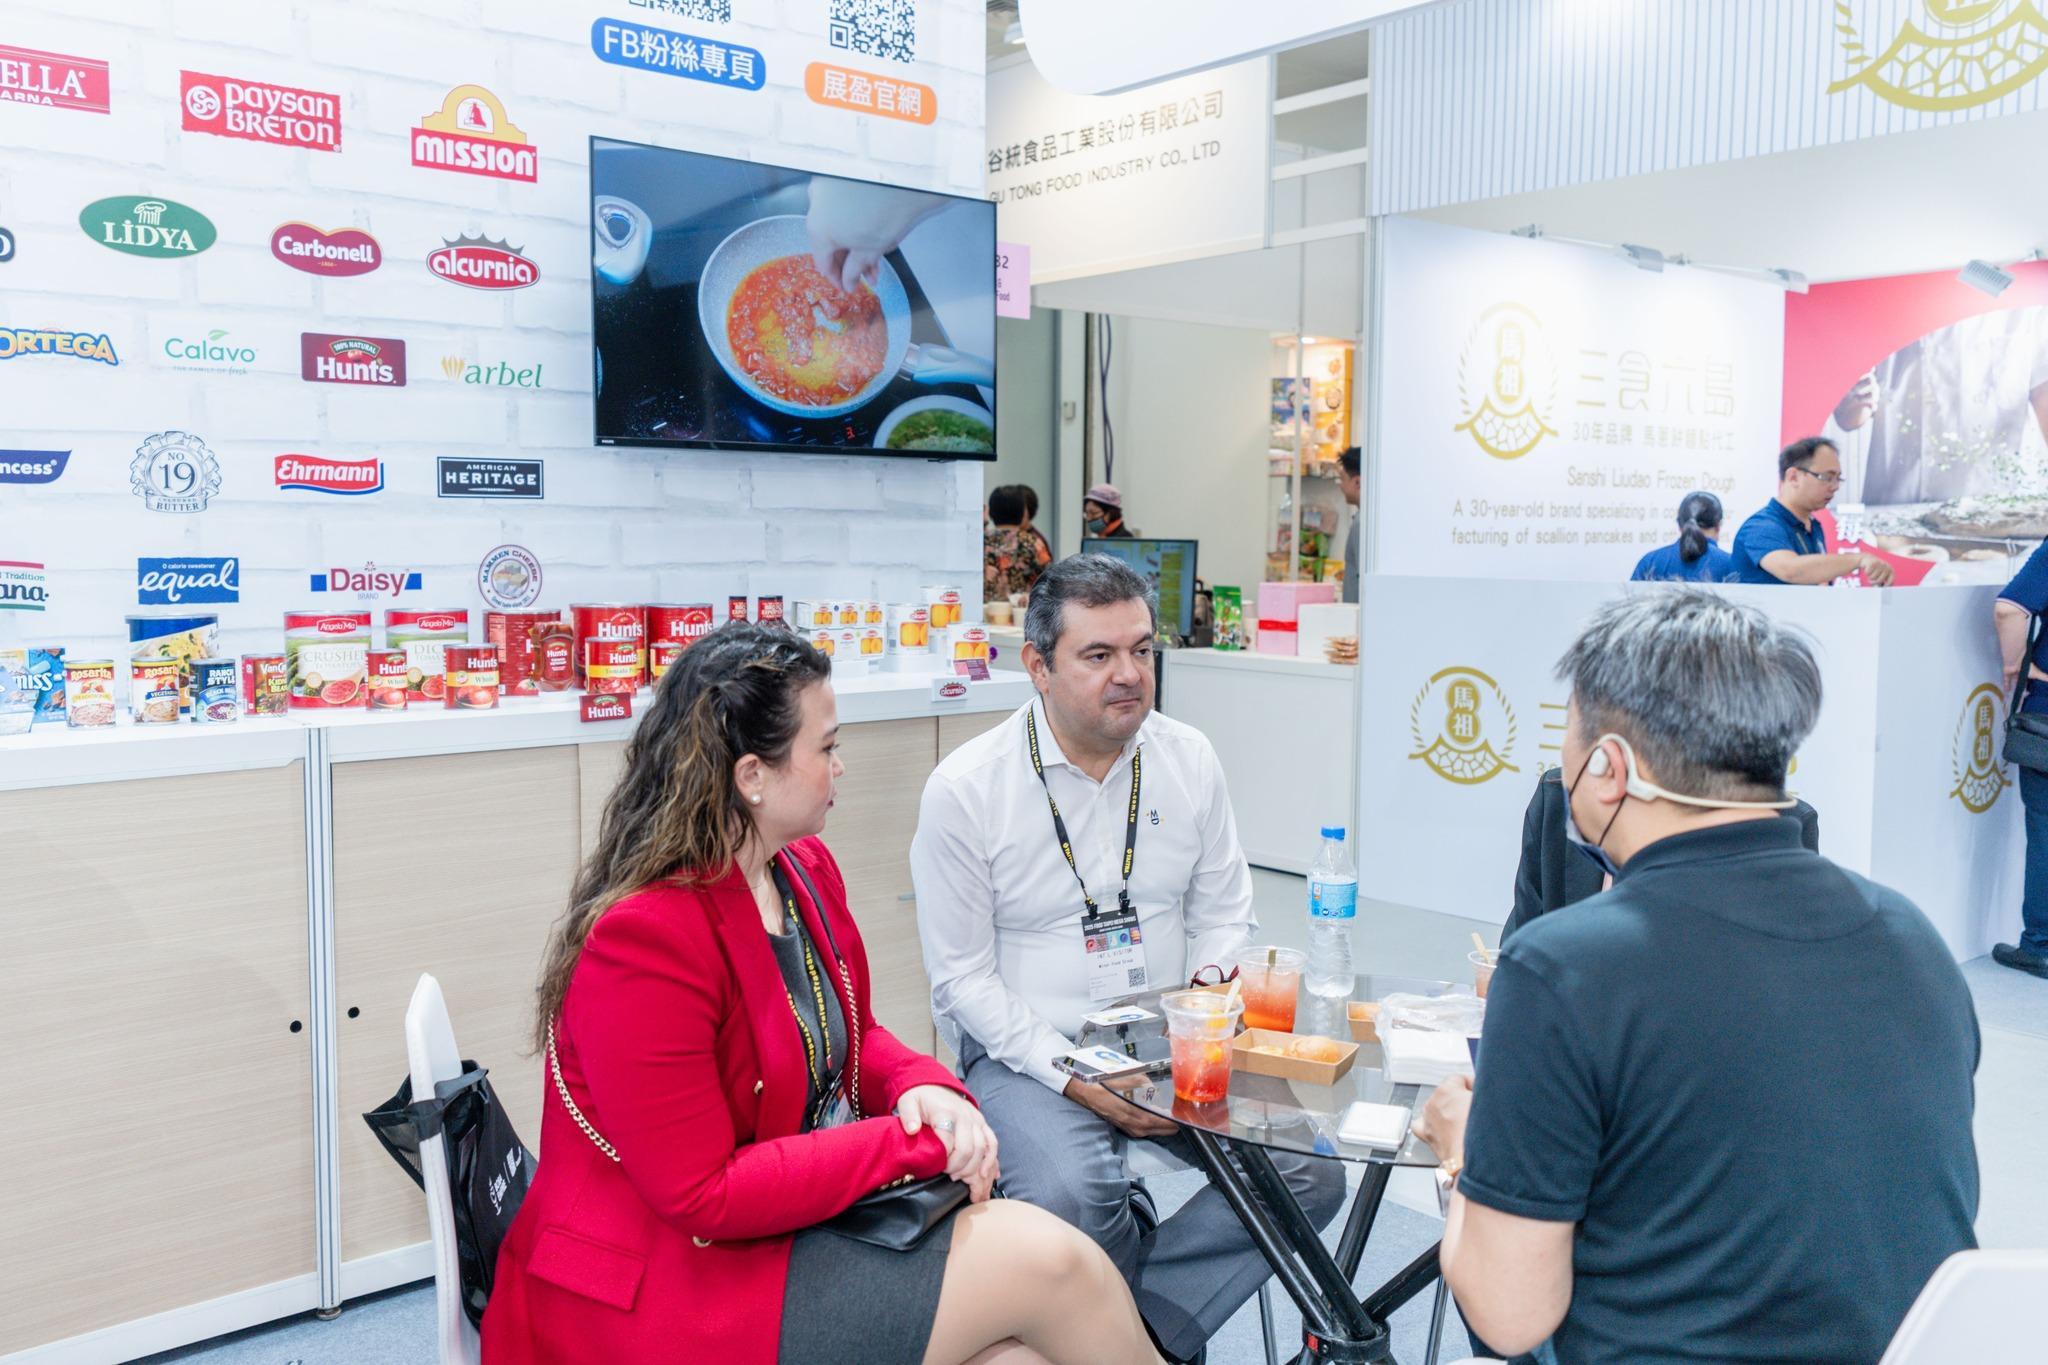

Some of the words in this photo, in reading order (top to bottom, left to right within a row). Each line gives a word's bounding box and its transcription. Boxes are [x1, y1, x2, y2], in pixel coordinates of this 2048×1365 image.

[603, 24, 756, 85] FB粉絲專頁
[822, 69, 922, 118] 展盈官網
[1009, 181, 1042, 201] TONG
[1046, 172, 1082, 194] FOOD
[1087, 155, 1154, 185] INDUSTRY
[1193, 140, 1221, 160] LTD
[278, 235, 374, 264] Carbonell
[432, 249, 532, 283] alcurnia
[165, 338, 256, 363] Calavo
[159, 462, 197, 494] 19
[278, 459, 376, 483] Ehrmann
[445, 471, 537, 487] HERITAGE
[466, 464, 517, 472] AMERICAN
[1657, 469, 1696, 490] Frozen
[1702, 471, 1737, 495] Dough
[156, 502, 200, 511] BUTTER
[1453, 500, 1464, 517] A
[1550, 501, 1582, 519] brand
[1587, 503, 1646, 522] specializing
[1650, 505, 1659, 518] in
[1452, 526, 1509, 548] facturing
[1516, 527, 1529, 545] of
[1536, 528, 1580, 546] scallion
[1584, 530, 1634, 548] pancakes
[1640, 532, 1658, 545] and
[140, 560, 239, 602] equal
[482, 550, 510, 583] MAMMEN
[511, 550, 538, 582] CHEESE
[330, 567, 405, 597] Daisy
